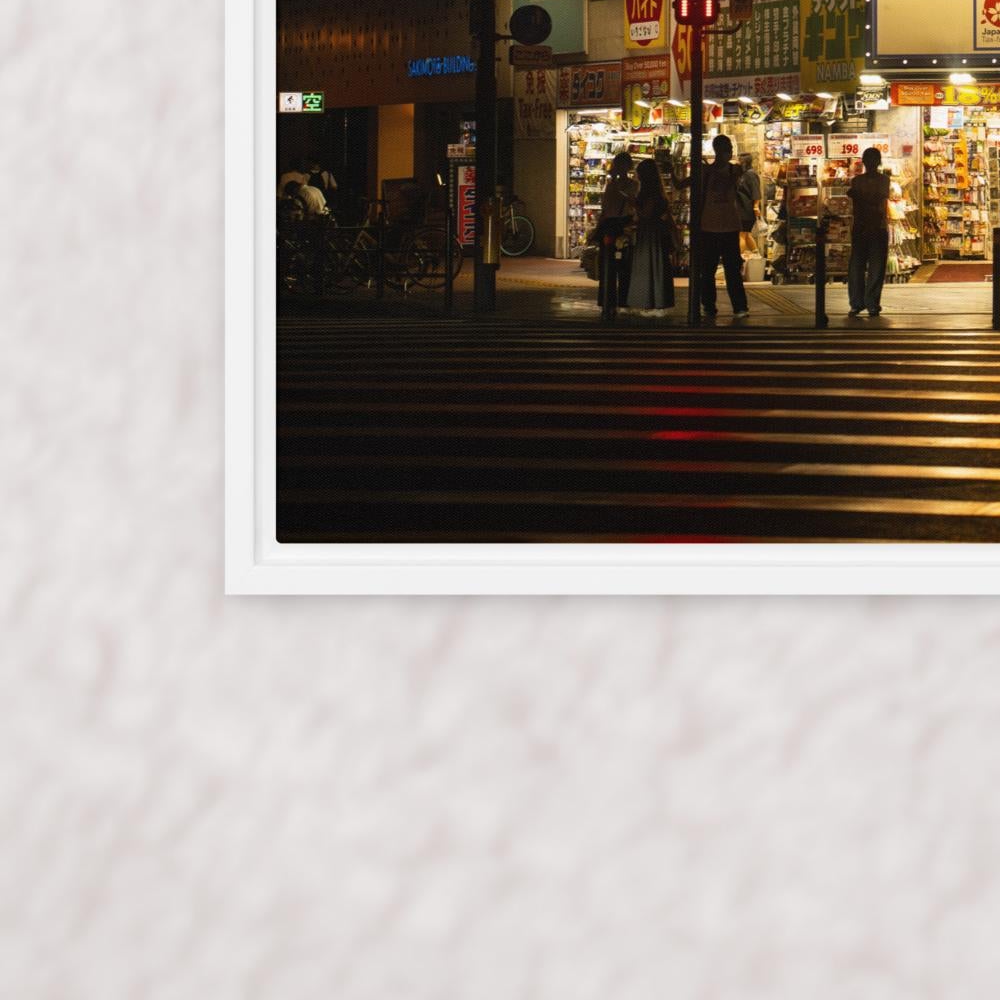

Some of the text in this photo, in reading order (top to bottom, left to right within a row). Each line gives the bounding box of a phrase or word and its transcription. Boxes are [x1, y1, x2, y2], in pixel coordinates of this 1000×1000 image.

[816, 62, 856, 81] NAMBA
[572, 69, 605, 100] ダイコク
[302, 92, 322, 111] 空
[805, 145, 823, 155] 698
[841, 143, 859, 154] 198
